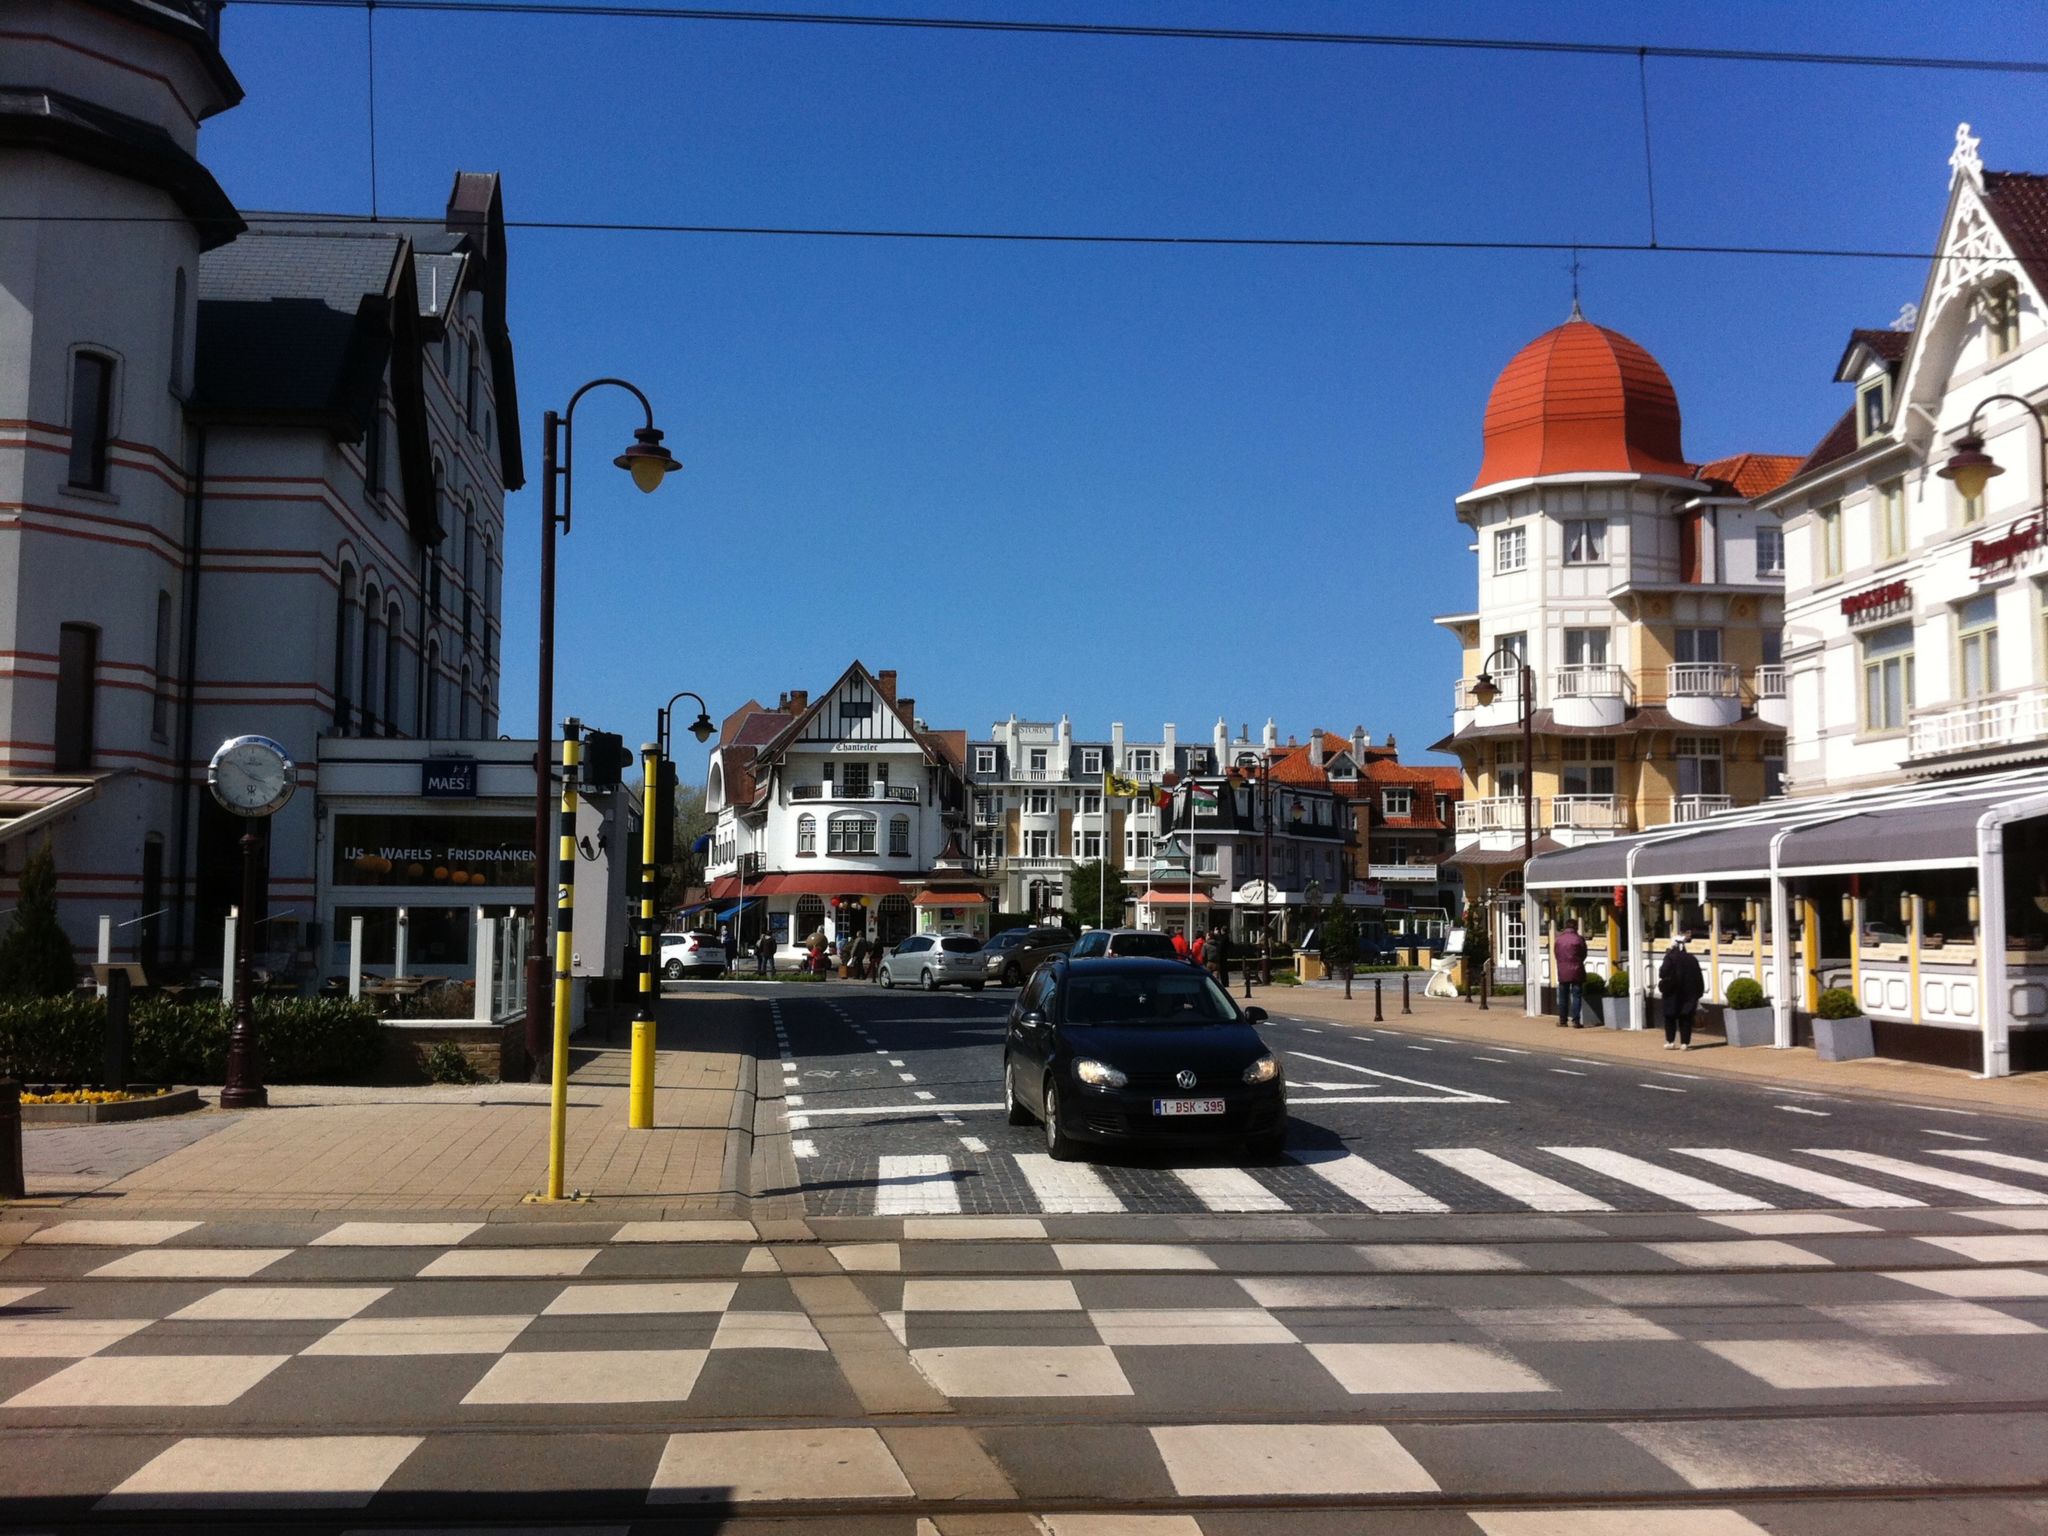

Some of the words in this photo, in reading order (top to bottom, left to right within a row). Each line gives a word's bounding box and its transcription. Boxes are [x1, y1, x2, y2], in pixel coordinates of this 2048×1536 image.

[428, 777, 465, 790] MAES
[344, 847, 364, 860] IJS
[380, 847, 432, 860] WAFELS
[448, 848, 536, 861] FRISDRANKEN
